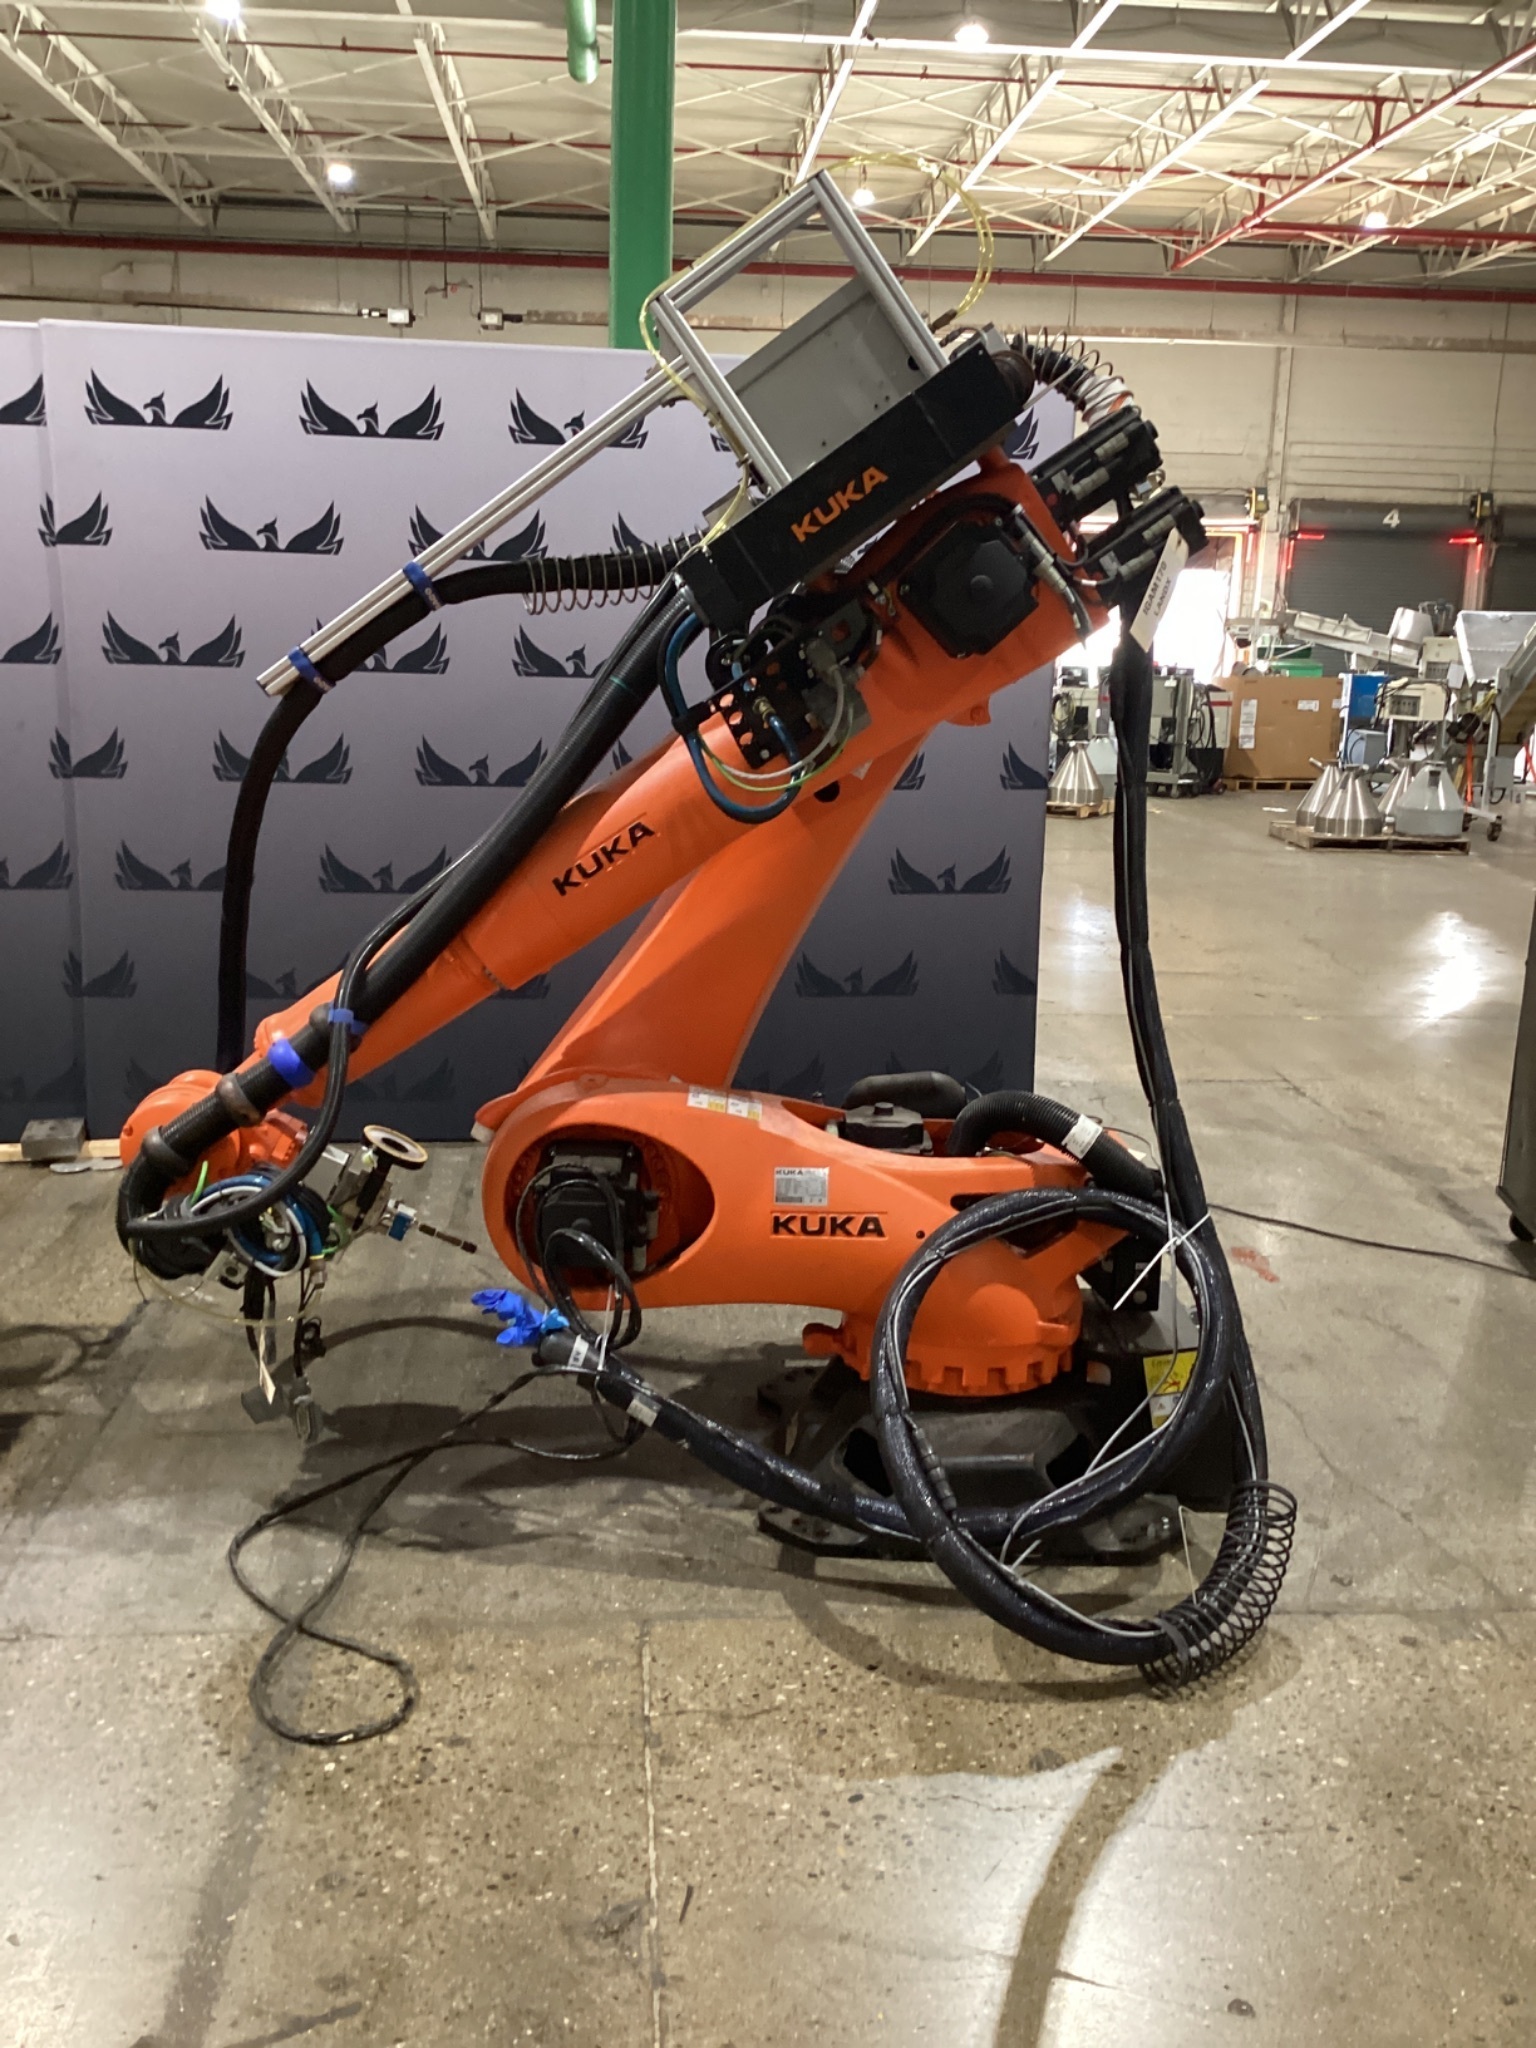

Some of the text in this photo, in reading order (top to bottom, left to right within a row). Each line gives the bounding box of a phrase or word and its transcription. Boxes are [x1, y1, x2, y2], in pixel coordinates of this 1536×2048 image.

[791, 466, 888, 543] KUKA
[1382, 509, 1400, 528] 4
[552, 821, 655, 896] KUKA
[773, 1215, 886, 1237] KUKA
